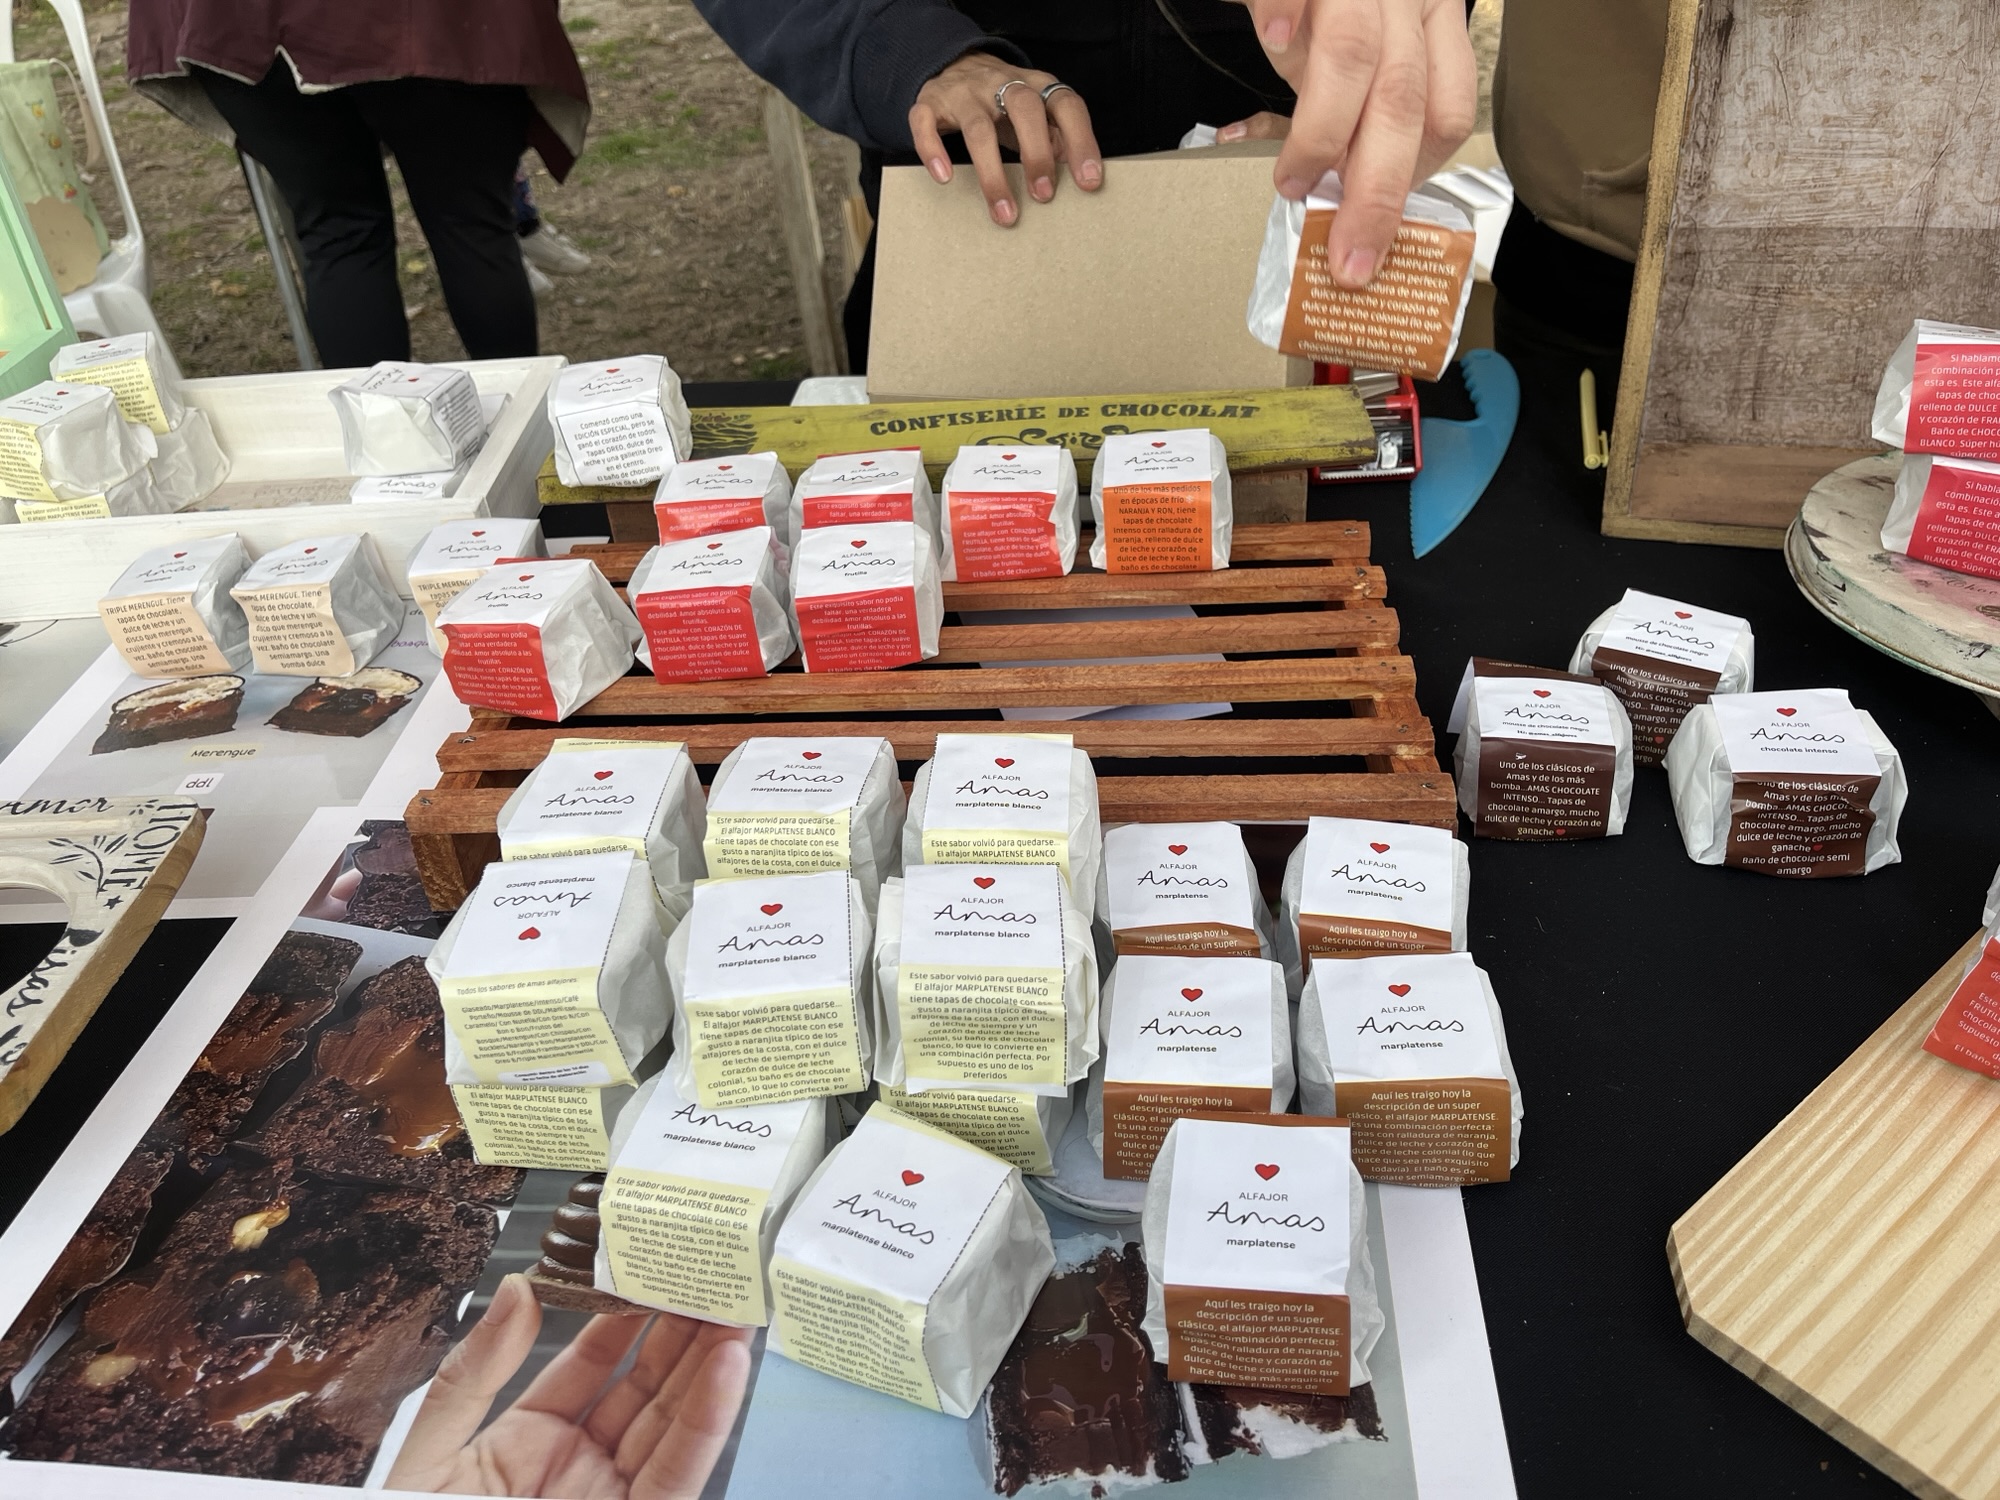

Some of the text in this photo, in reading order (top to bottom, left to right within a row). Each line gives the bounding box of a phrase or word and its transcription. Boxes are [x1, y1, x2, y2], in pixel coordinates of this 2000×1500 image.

[579, 378, 643, 391] Amas
[1968, 404, 1997, 412] DULCE
[580, 412, 643, 429] Comenzó como una
[870, 404, 1261, 435] CONFISERIE DE CHOCOLAT
[574, 431, 599, 440] EDICIÓN
[600, 426, 630, 436] ESPECIAL,
[631, 421, 646, 430] pero
[1960, 440, 1987, 448] Súper
[1124, 456, 1194, 466] Amas
[974, 466, 1041, 475] Amas
[379, 479, 436, 488] Amas
[686, 477, 753, 486] Amas
[832, 472, 899, 483] Amas
[1156, 516, 1193, 524] chocolate
[438, 544, 502, 554] Amas
[670, 558, 743, 572] Amas
[822, 558, 895, 571] Amas
[136, 564, 197, 579] Amas
[475, 592, 543, 601] Amas
[106, 605, 128, 615] TRIPLE
[166, 596, 186, 605] Tiene
[1659, 620, 1694, 631] ALFAJOR
[1633, 622, 1715, 649] Amas
[1625, 636, 1649, 644] mousse
[1658, 643, 1688, 652] chocolate
[1689, 649, 1708, 657] negro
[1504, 707, 1590, 724] Amas
[1750, 728, 1845, 743] Amas
[191, 747, 256, 759] Merengue
[1500, 761, 1516, 769] Uno
[1532, 762, 1544, 770] los
[1546, 763, 1582, 773] clásicos
[1584, 765, 1595, 773] de
[756, 769, 844, 784] Amas
[186, 778, 213, 789] ddl
[956, 780, 1049, 800] Amas
[545, 793, 635, 807] Amas
[955, 802, 1042, 810] marplatense blanco
[540, 812, 593, 820] marplatense
[98, 802, 198, 892] HOME
[1357, 859, 1397, 870] ALFAJOR
[1781, 855, 1824, 863] chocolate
[1827, 853, 1850, 861] semi
[1777, 867, 1812, 875] amargo
[539, 877, 595, 887] marplatense
[1137, 870, 1228, 888] Amas
[1331, 864, 1426, 892] Amas
[494, 892, 592, 908] Amas
[1348, 888, 1403, 901] marplatense
[518, 910, 561, 919] ALFAJOR
[933, 904, 1037, 924] Amas
[746, 922, 791, 932] ALFAJOR
[935, 930, 995, 938] marplatense
[718, 933, 824, 953] Amas
[718, 954, 817, 968] marplatense blanco
[696, 1000, 843, 1019] Este sabor volvió para quedarse...
[1381, 1006, 1426, 1014] ALFAJOR
[712, 1020, 740, 1030] alfajor
[743, 1013, 802, 1026] MARPLATENSE
[804, 1012, 838, 1022] BLANCO
[1140, 1018, 1242, 1037] Amas
[1357, 1017, 1464, 1035] Amas
[1157, 1045, 1217, 1053] marplatense
[1381, 1041, 1444, 1050] marplatense
[671, 1103, 771, 1138] Amas
[663, 1132, 756, 1152] marplatense blanco
[872, 1188, 917, 1210] ALFAJOR
[1239, 1192, 1289, 1202] ALFAJOR
[832, 1194, 934, 1245] Amas
[1207, 1201, 1325, 1232] Amas
[821, 1220, 914, 1260] marplatense blanco
[1227, 1237, 1296, 1249] marplatense
[1205, 1298, 1314, 1313] Aquí les traigo hoy la
